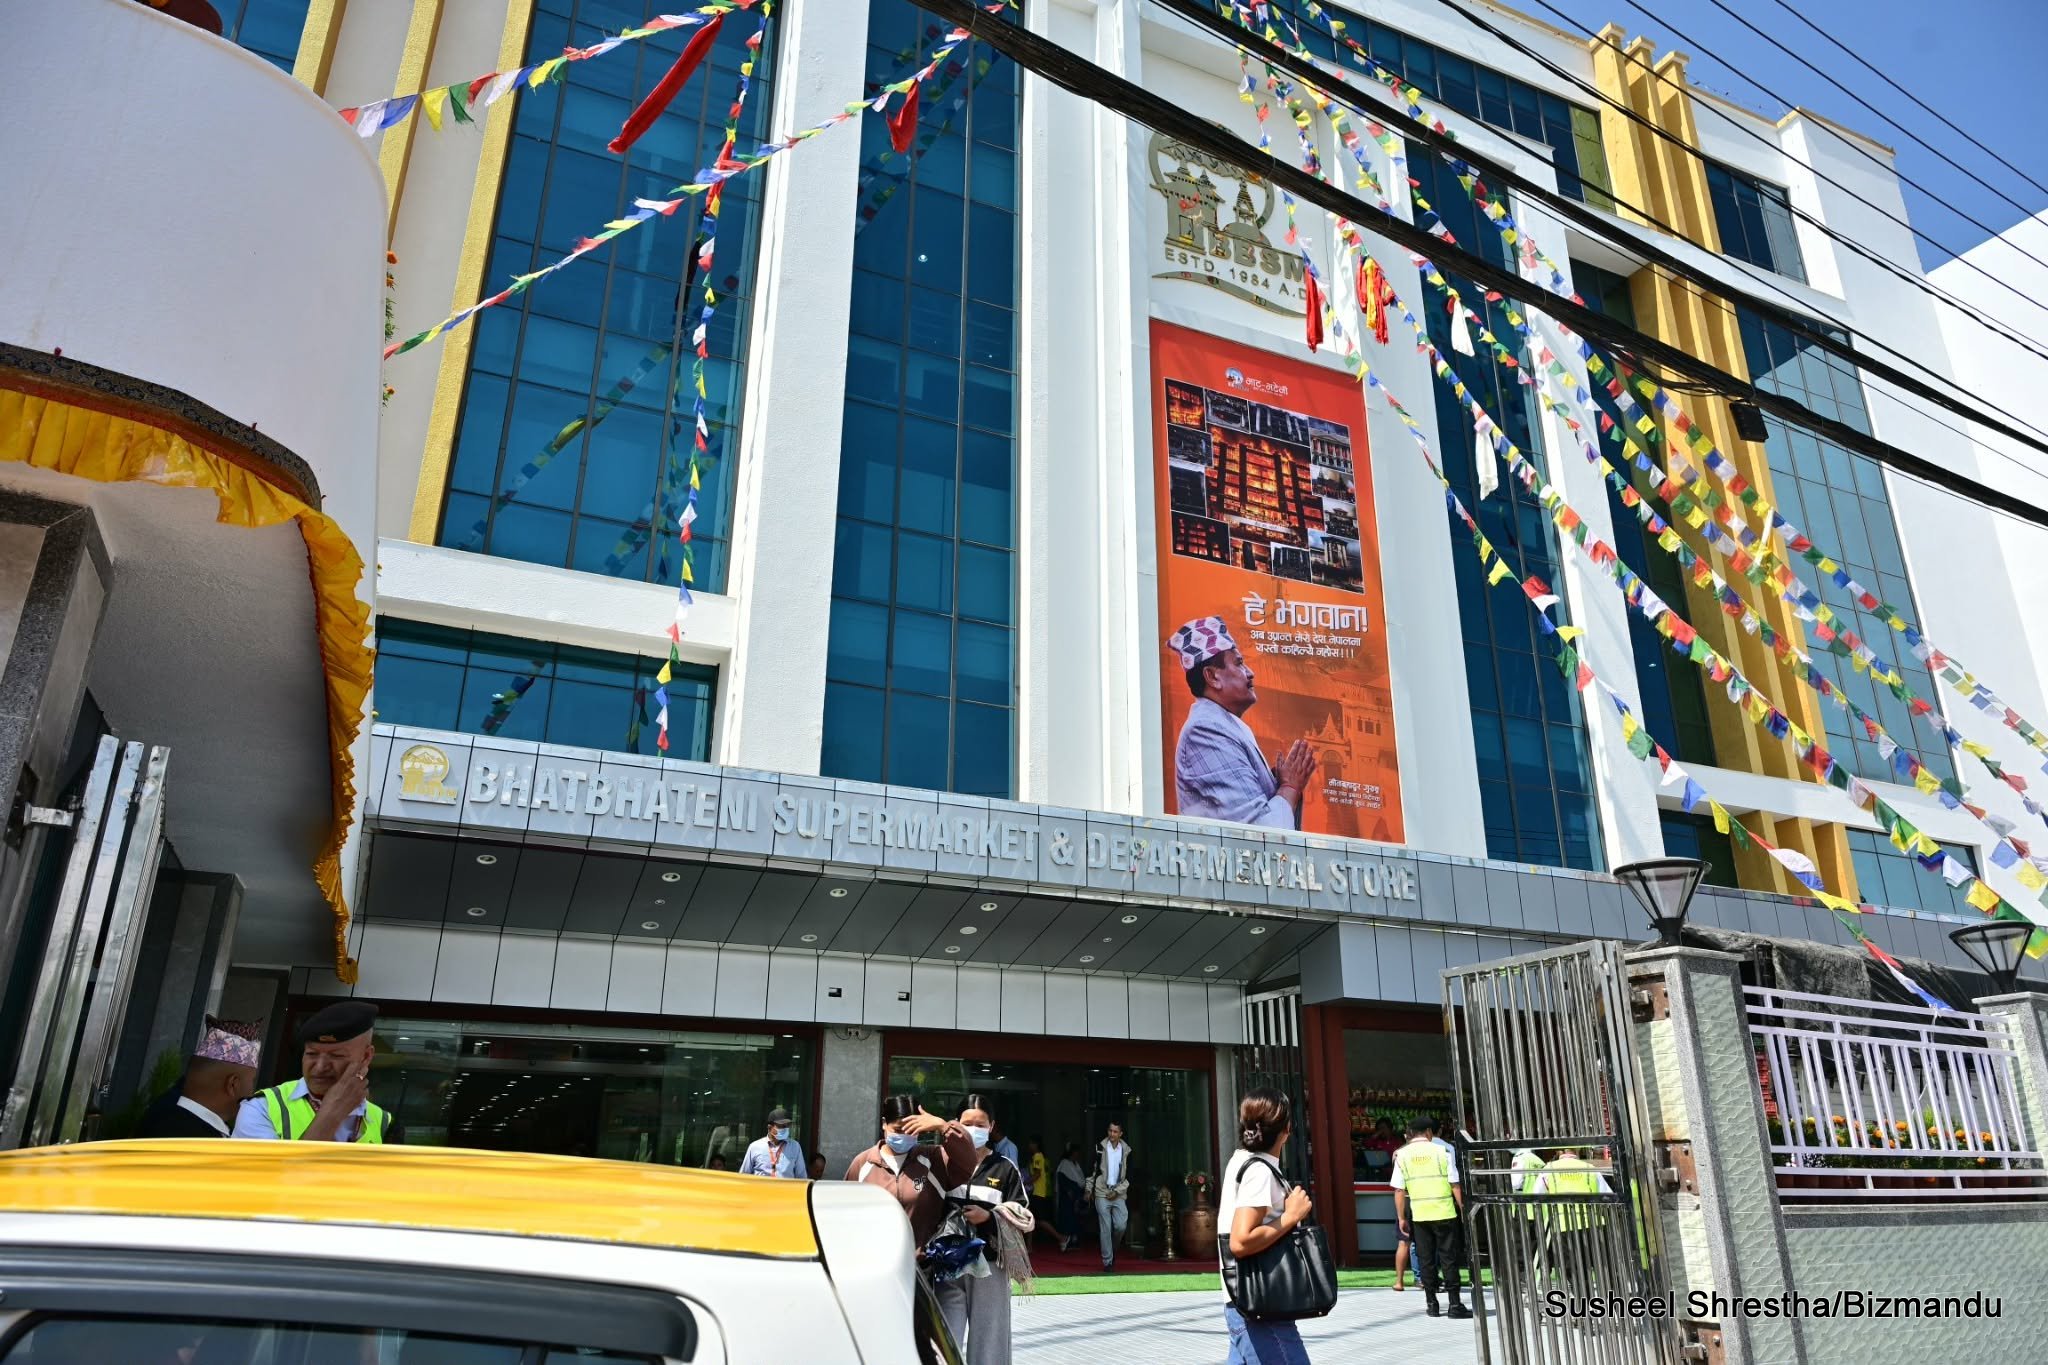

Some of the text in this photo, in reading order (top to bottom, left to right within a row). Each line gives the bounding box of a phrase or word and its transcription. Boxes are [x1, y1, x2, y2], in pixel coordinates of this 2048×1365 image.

[1165, 247, 1220, 275] ESTD.
[1229, 267, 1270, 290] 1984
[1241, 591, 1367, 632] हे भगवान!
[1250, 629, 1362, 647] अब उप्रान्त मेरो देश नेपालमा
[1255, 641, 1279, 654] यस्तो
[469, 760, 1417, 901] BHATBHATENI SUPERMARKET & DEPARTMENTAL STORE
